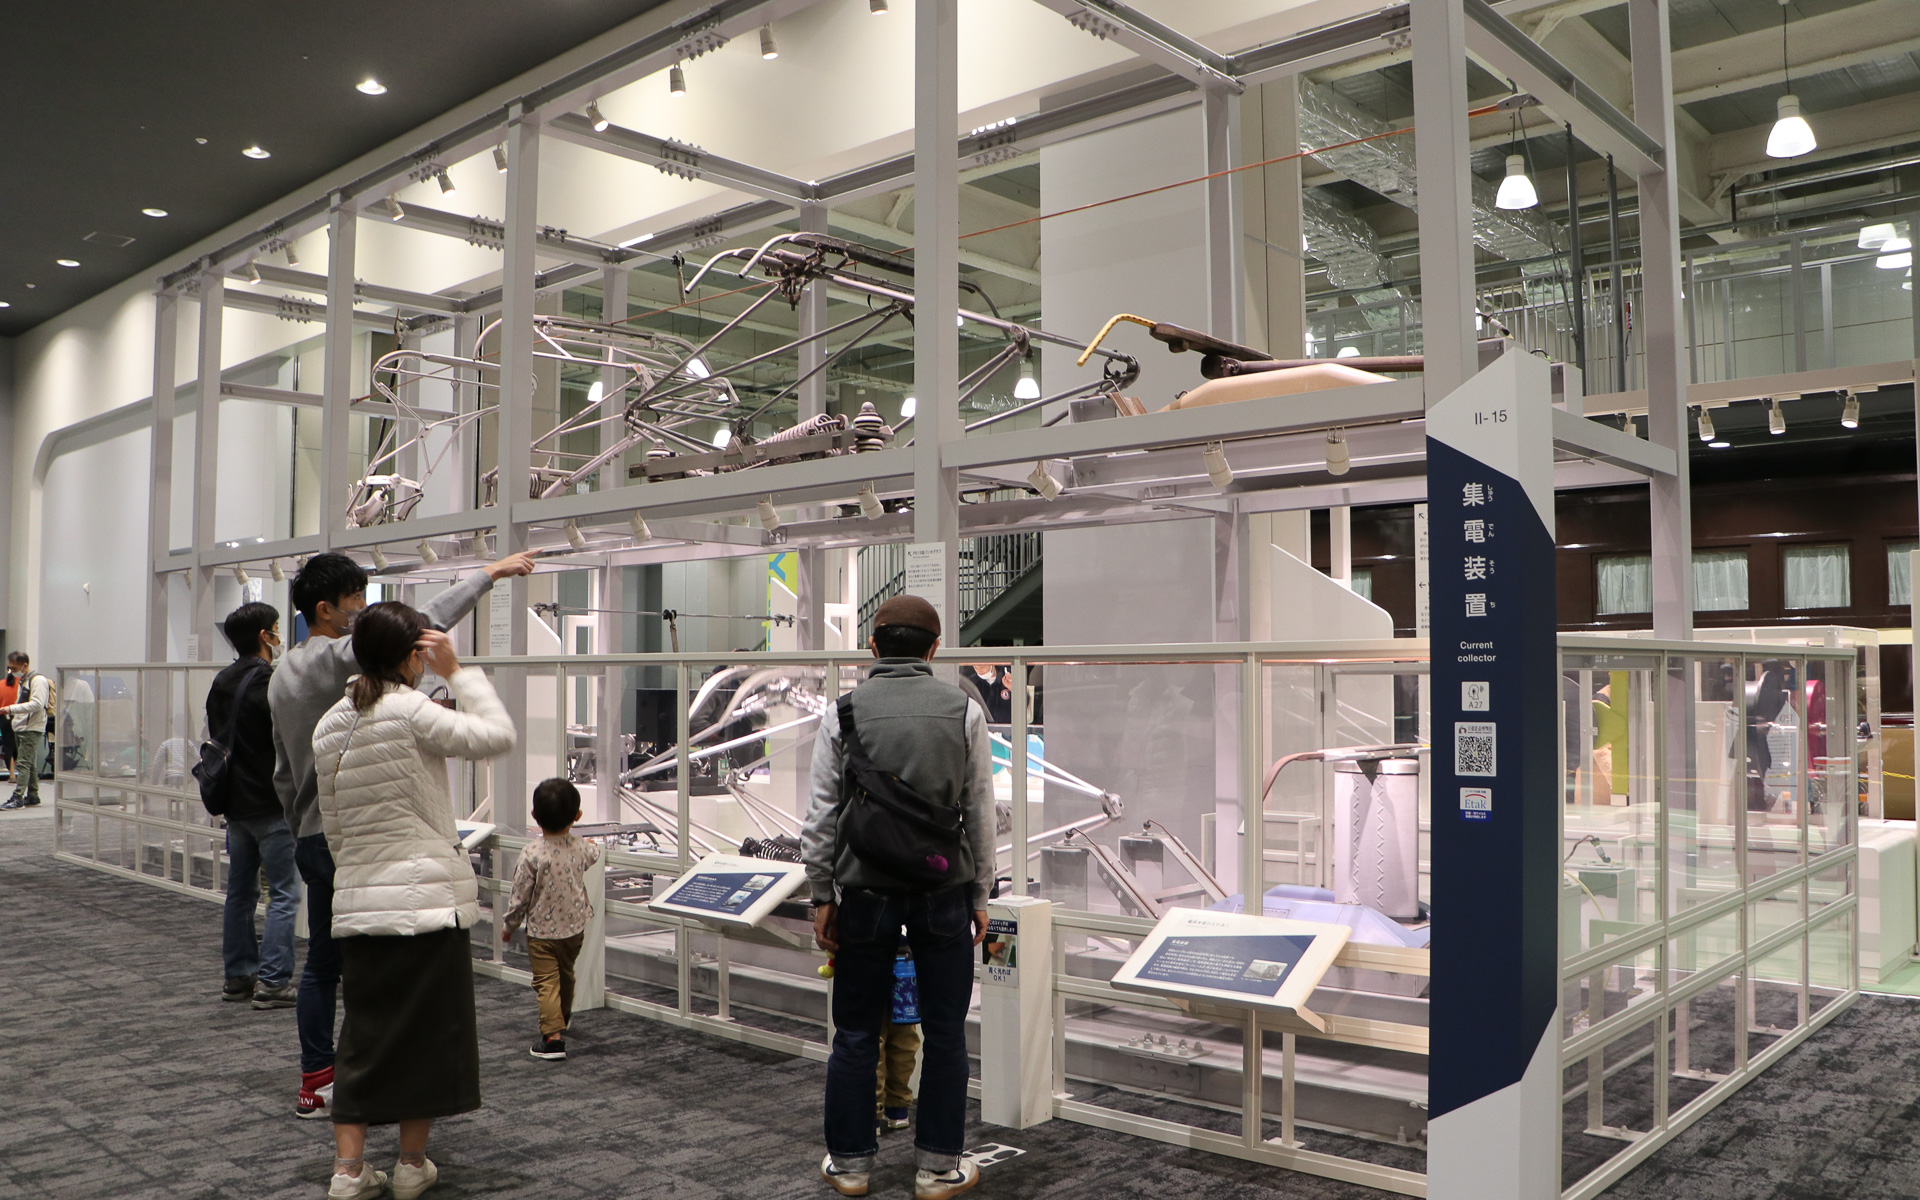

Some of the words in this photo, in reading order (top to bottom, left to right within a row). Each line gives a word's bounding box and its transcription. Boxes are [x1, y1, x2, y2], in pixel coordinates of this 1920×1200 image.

[1487, 523, 1495, 538] でん
[1461, 482, 1488, 618] 集電装置
[1488, 560, 1495, 574] そう
[1489, 601, 1496, 609] ち
[1460, 641, 1494, 650] Current
[1457, 654, 1497, 662] collector
[1465, 799, 1487, 809] Etak
[298, 1096, 313, 1105] ANI
